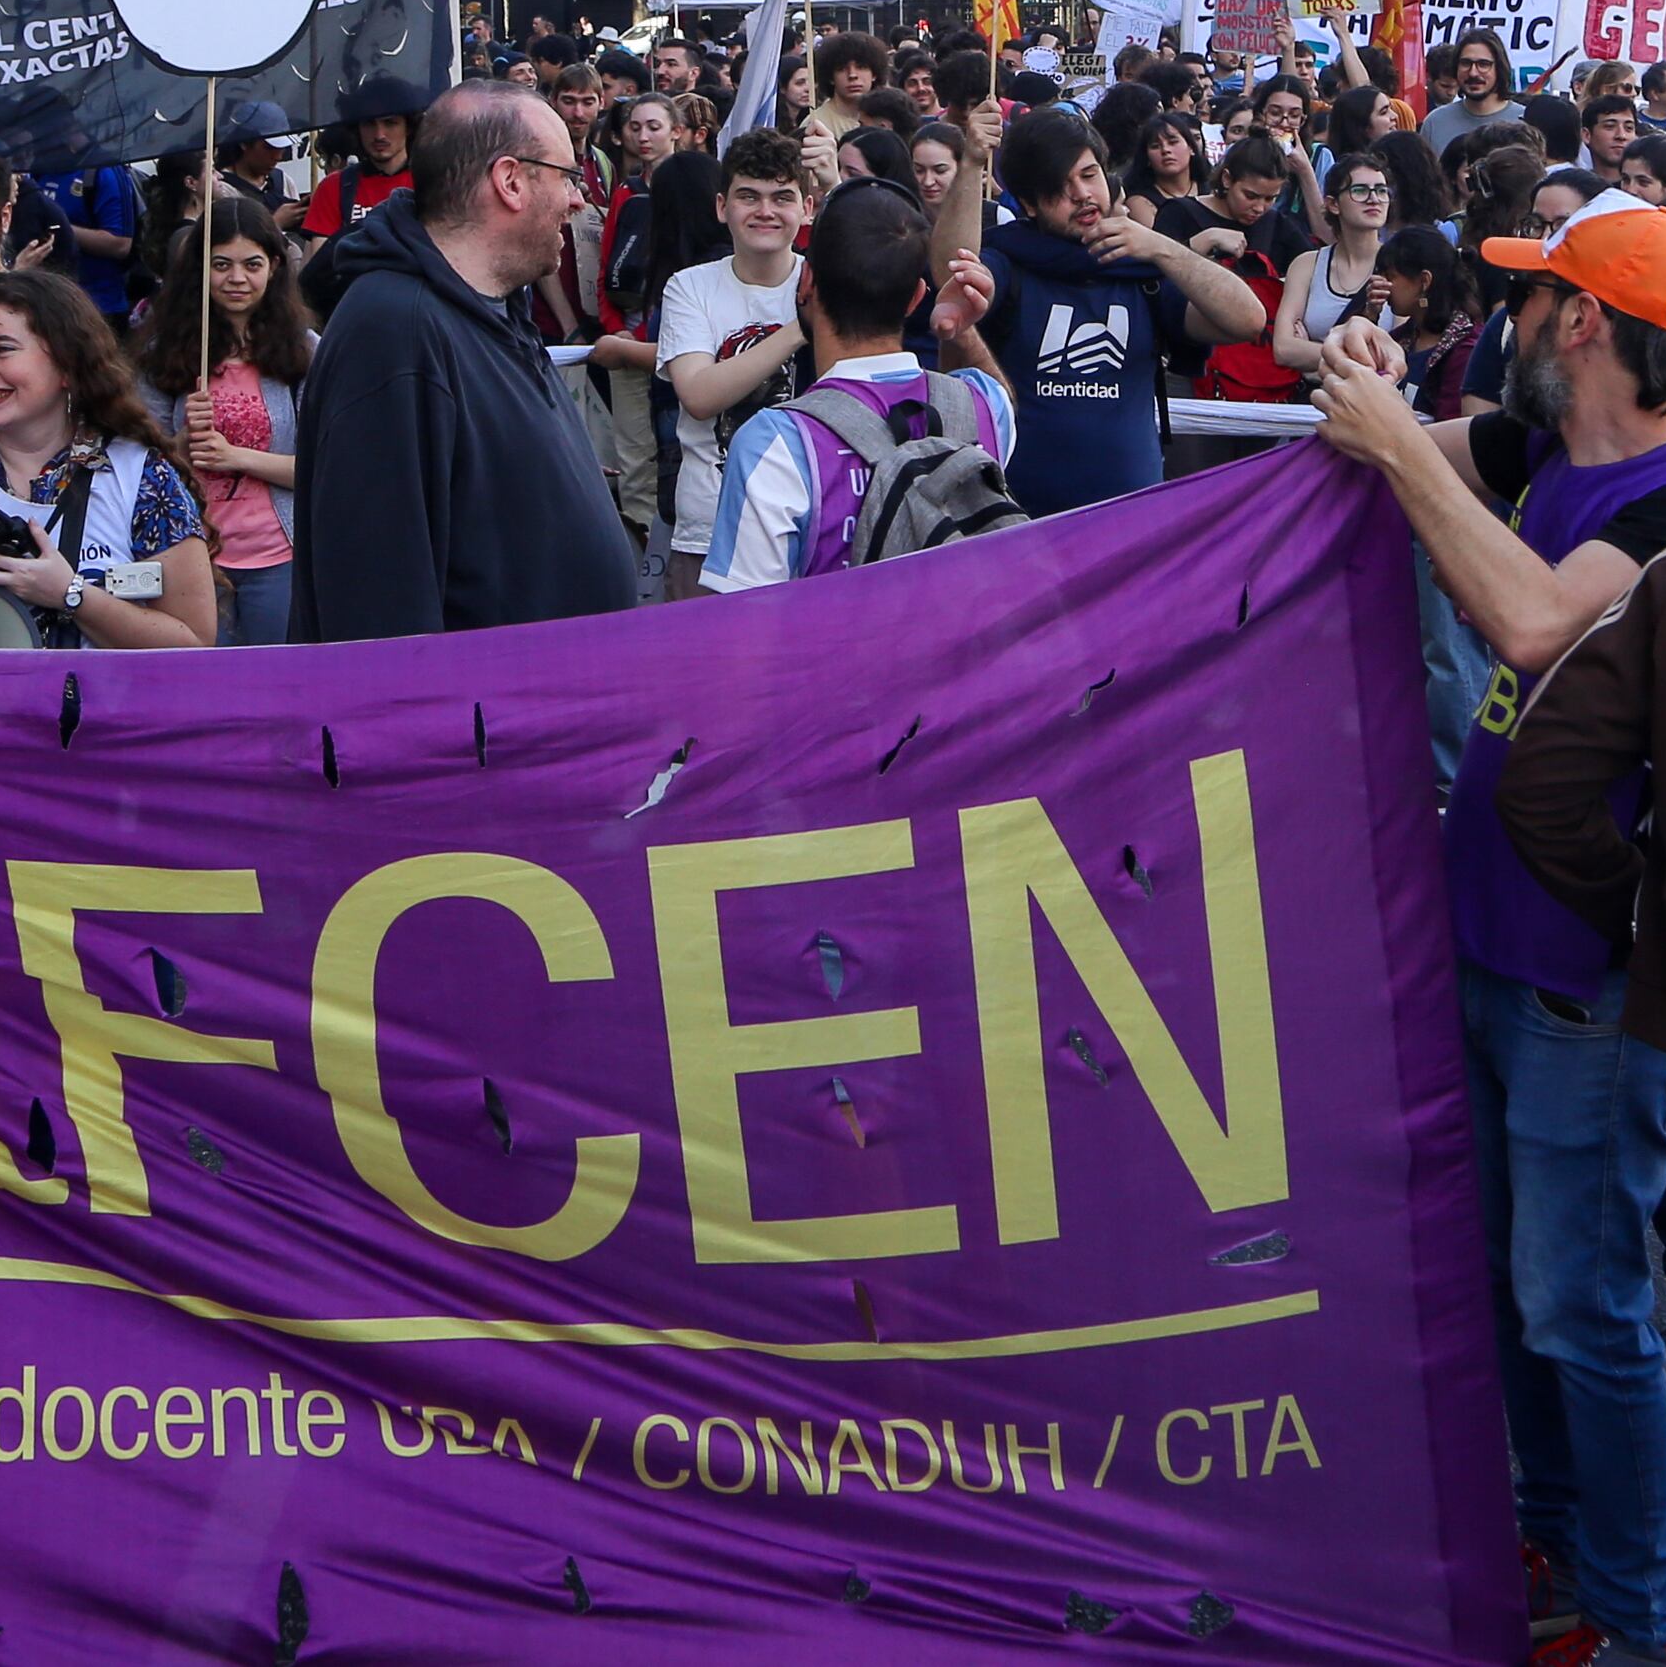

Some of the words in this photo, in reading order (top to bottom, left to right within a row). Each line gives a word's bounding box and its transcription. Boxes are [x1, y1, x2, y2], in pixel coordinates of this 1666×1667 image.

[1036, 380, 1120, 399] Identidad
[632, 1412, 1066, 1496] CONADUH
[1154, 1393, 1322, 1486] CTA
